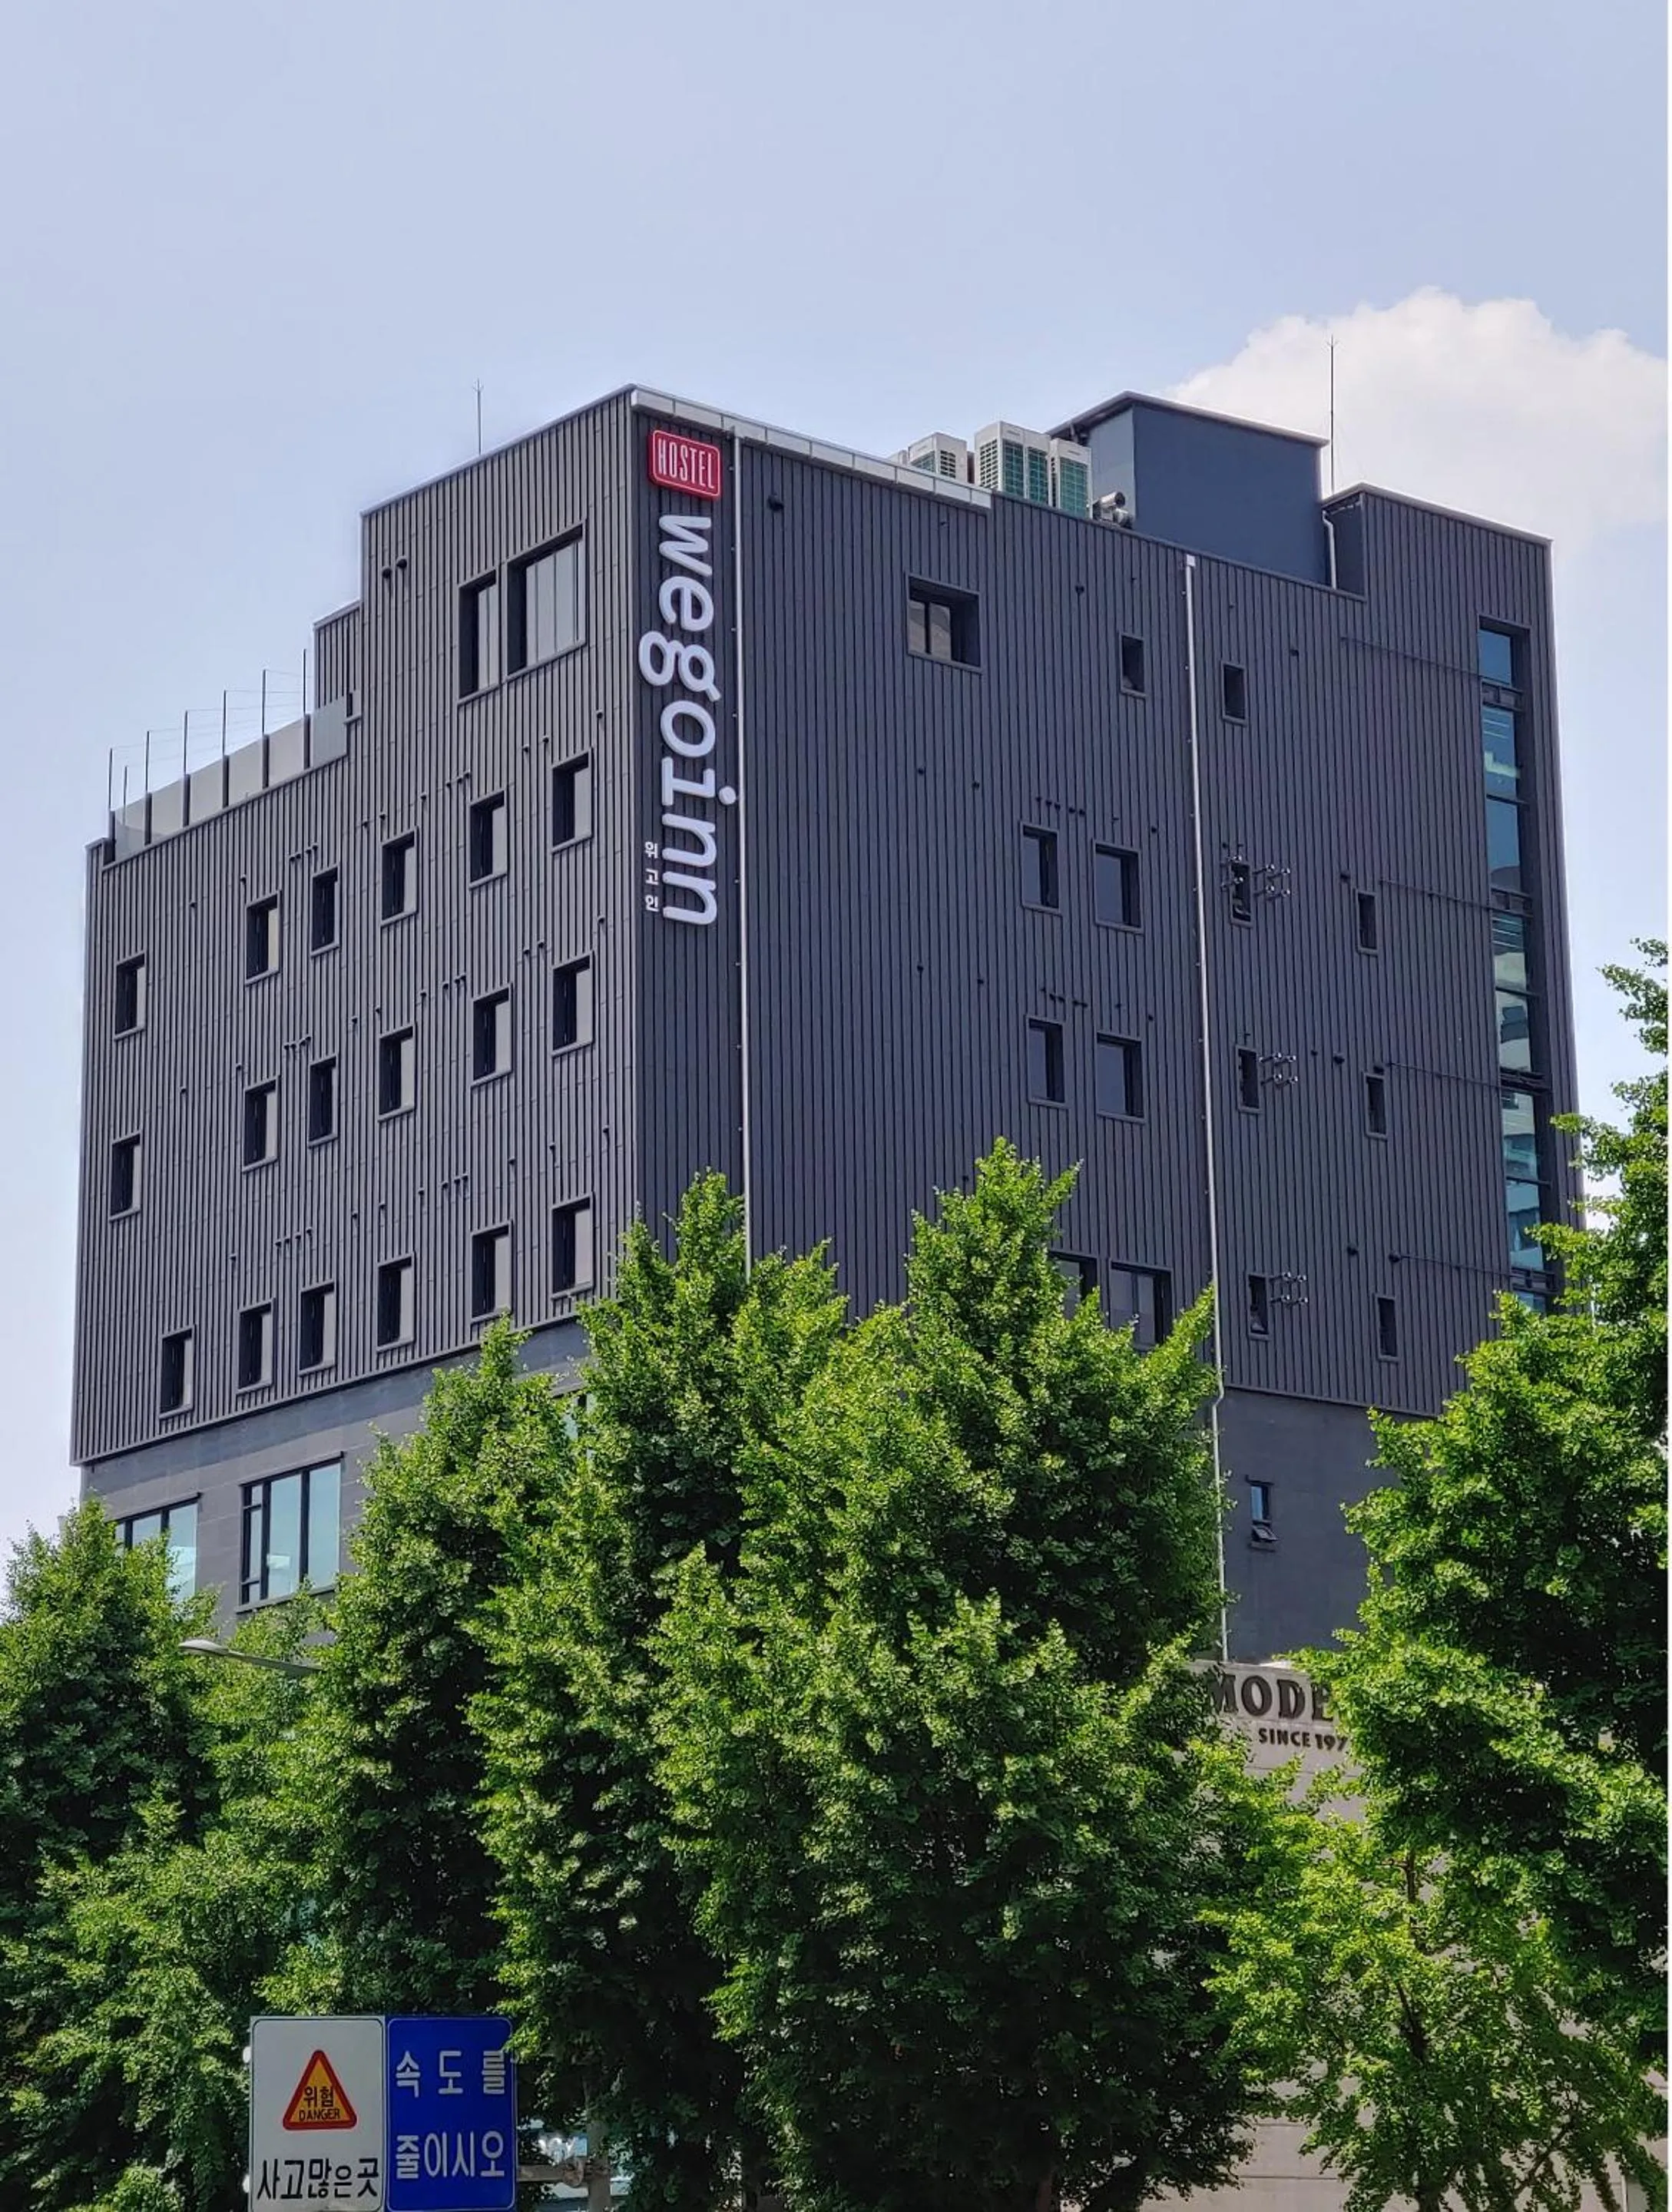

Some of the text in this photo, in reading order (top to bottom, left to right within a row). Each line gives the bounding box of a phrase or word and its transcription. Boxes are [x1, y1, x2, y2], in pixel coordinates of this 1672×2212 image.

[657, 438, 715, 490] HOSTEL
[638, 515, 737, 925] wegoinn
[1259, 1728, 1311, 1748] SINCE
[299, 2108, 340, 2121] DANGER
[303, 2085, 334, 2108] 위험
[396, 2130, 505, 2180] 줄이시오
